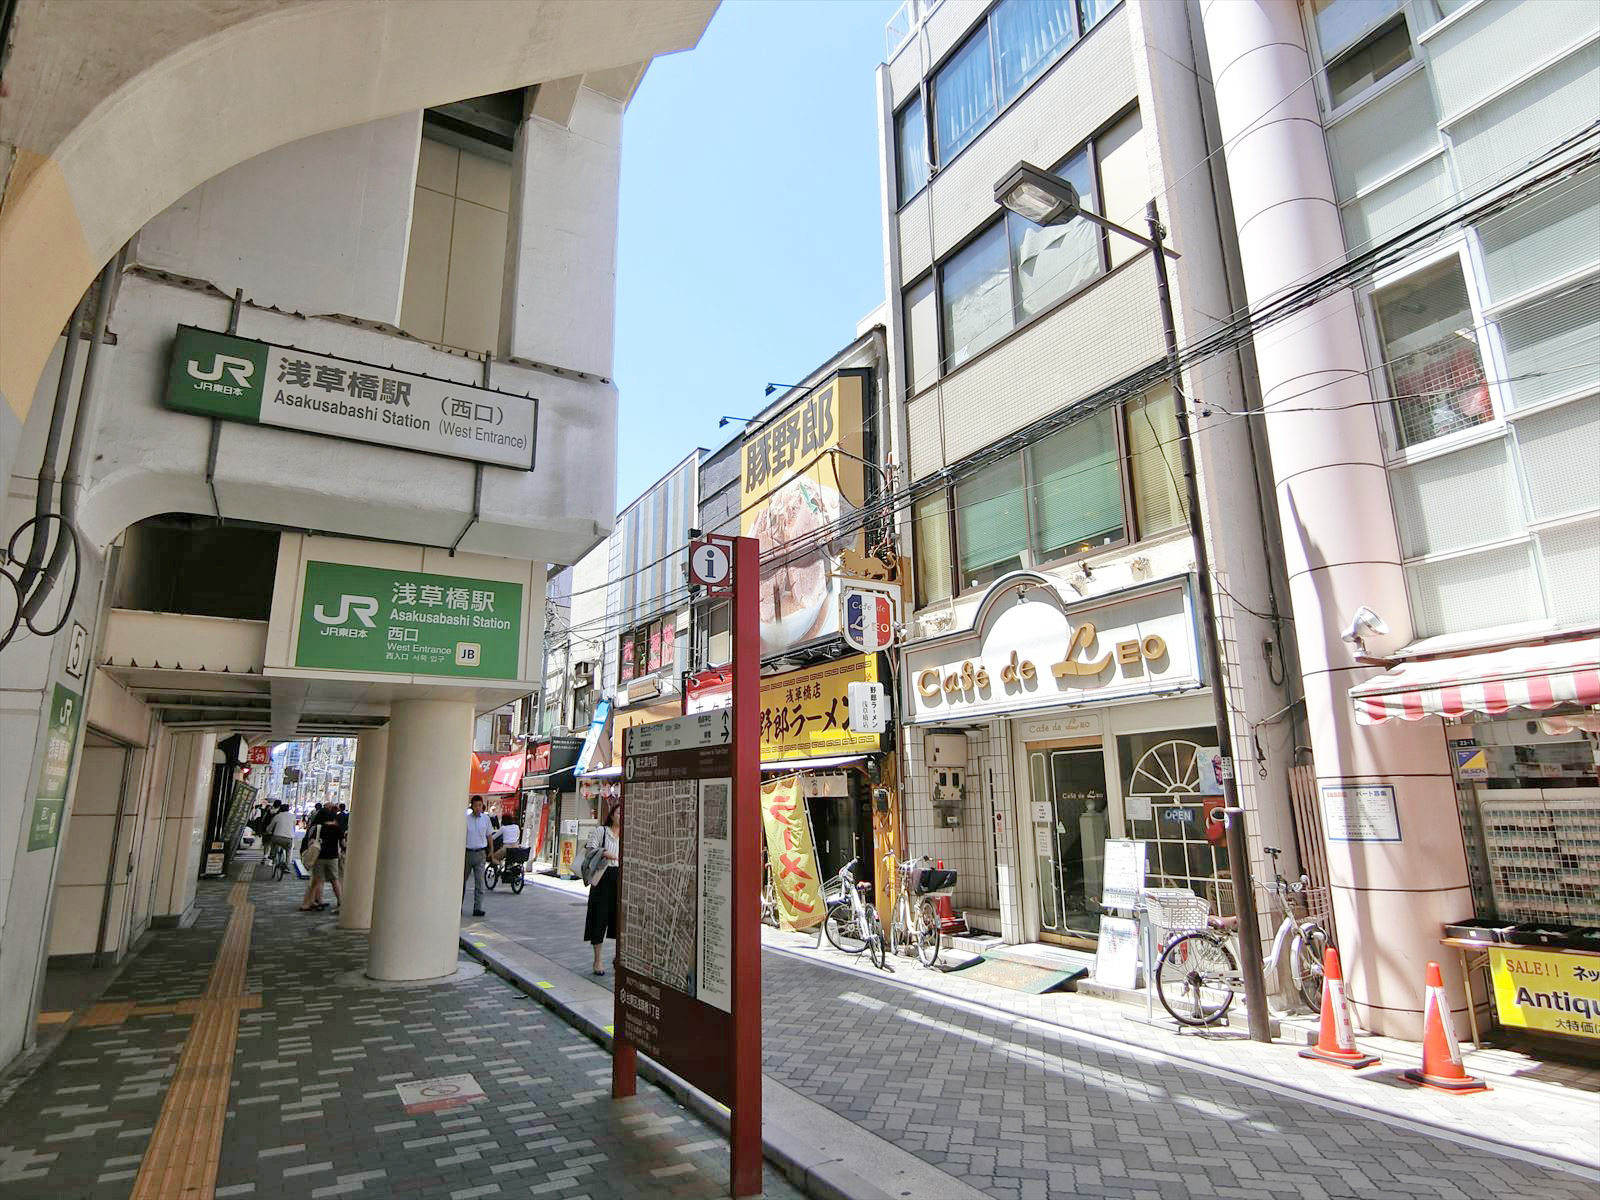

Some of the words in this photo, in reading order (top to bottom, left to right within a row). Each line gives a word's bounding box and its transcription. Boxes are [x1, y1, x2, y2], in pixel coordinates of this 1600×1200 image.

[187, 353, 255, 388] JR
[277, 357, 411, 407] 浅草橋駅
[193, 381, 243, 396] JR東日本
[273, 389, 378, 421] Asakusabashi
[382, 409, 430, 431] Station
[439, 419, 472, 439] (West
[475, 427, 527, 450] Entrance)
[745, 385, 834, 494] 豚野郎
[313, 594, 379, 628] JR
[391, 582, 495, 613] 浅草橋駅
[320, 627, 368, 639] JR東日本
[388, 626, 419, 642] 西口
[389, 608, 470, 627] Asakusabashi
[472, 614, 511, 630] Station
[387, 642, 410, 652] West
[412, 643, 452, 655] Entrance
[461, 648, 475, 660] JB
[1000, 650, 1036, 684] de
[785, 682, 821, 704] 浅草橋店
[869, 686, 878, 729] 野郎ラーメン
[1165, 810, 1192, 821] OPEN
